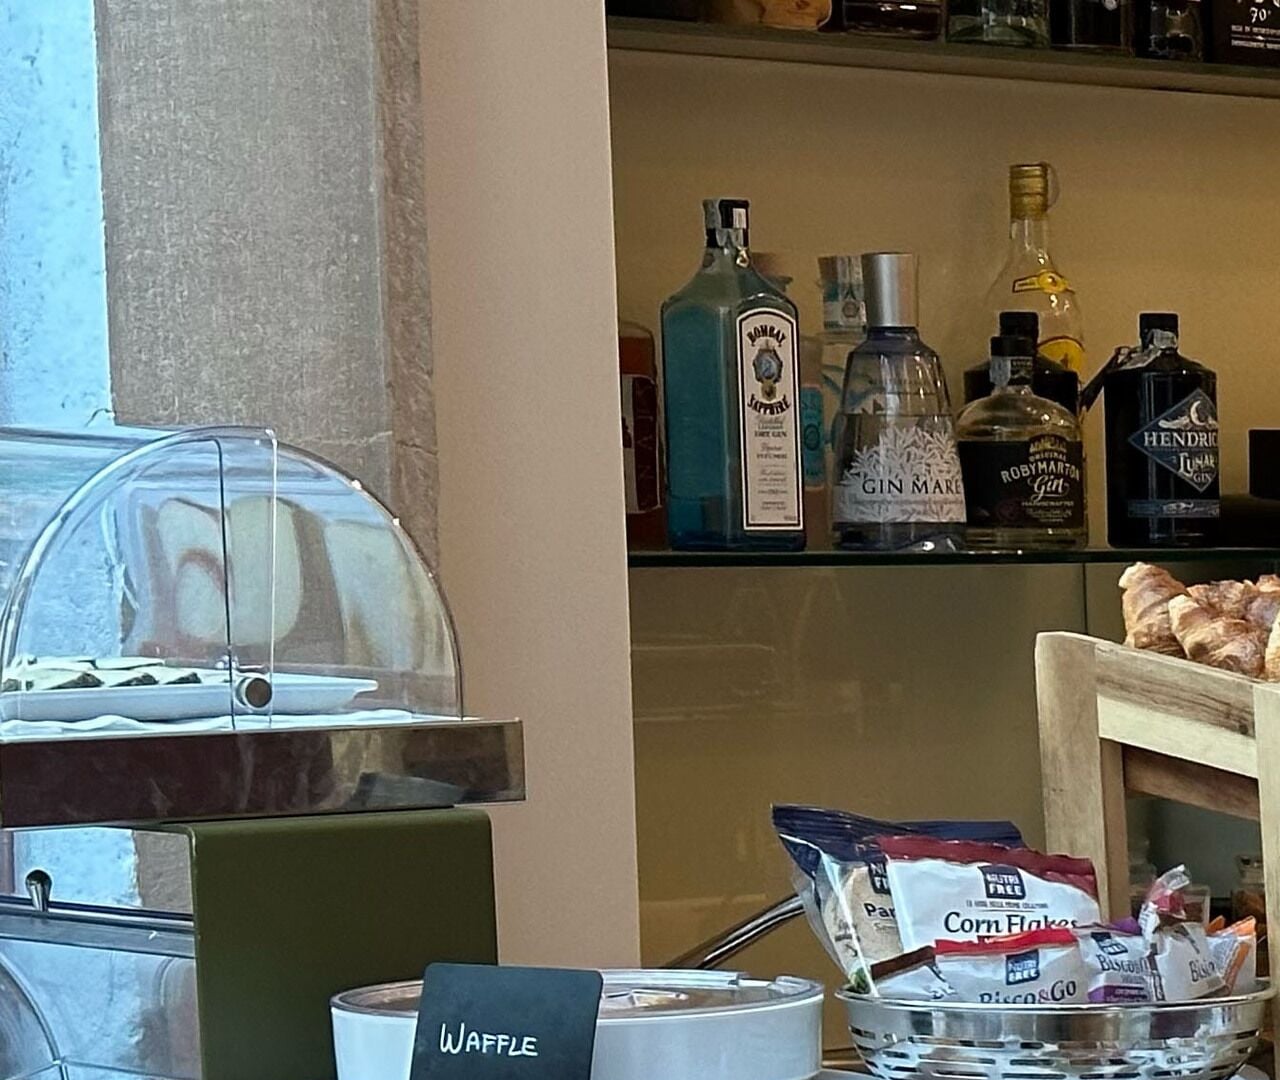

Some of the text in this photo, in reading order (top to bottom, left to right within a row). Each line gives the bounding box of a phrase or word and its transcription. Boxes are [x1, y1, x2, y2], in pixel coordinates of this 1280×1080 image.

[747, 325, 786, 347] BOMBAY
[747, 394, 791, 415] SAPPHIRE
[862, 479, 961, 494] GIN MARE
[1031, 475, 1067, 503] Gin
[988, 884, 1022, 897] FREE
[944, 911, 1078, 934] Corn Flakes
[440, 1023, 538, 1057] WAFFLE
